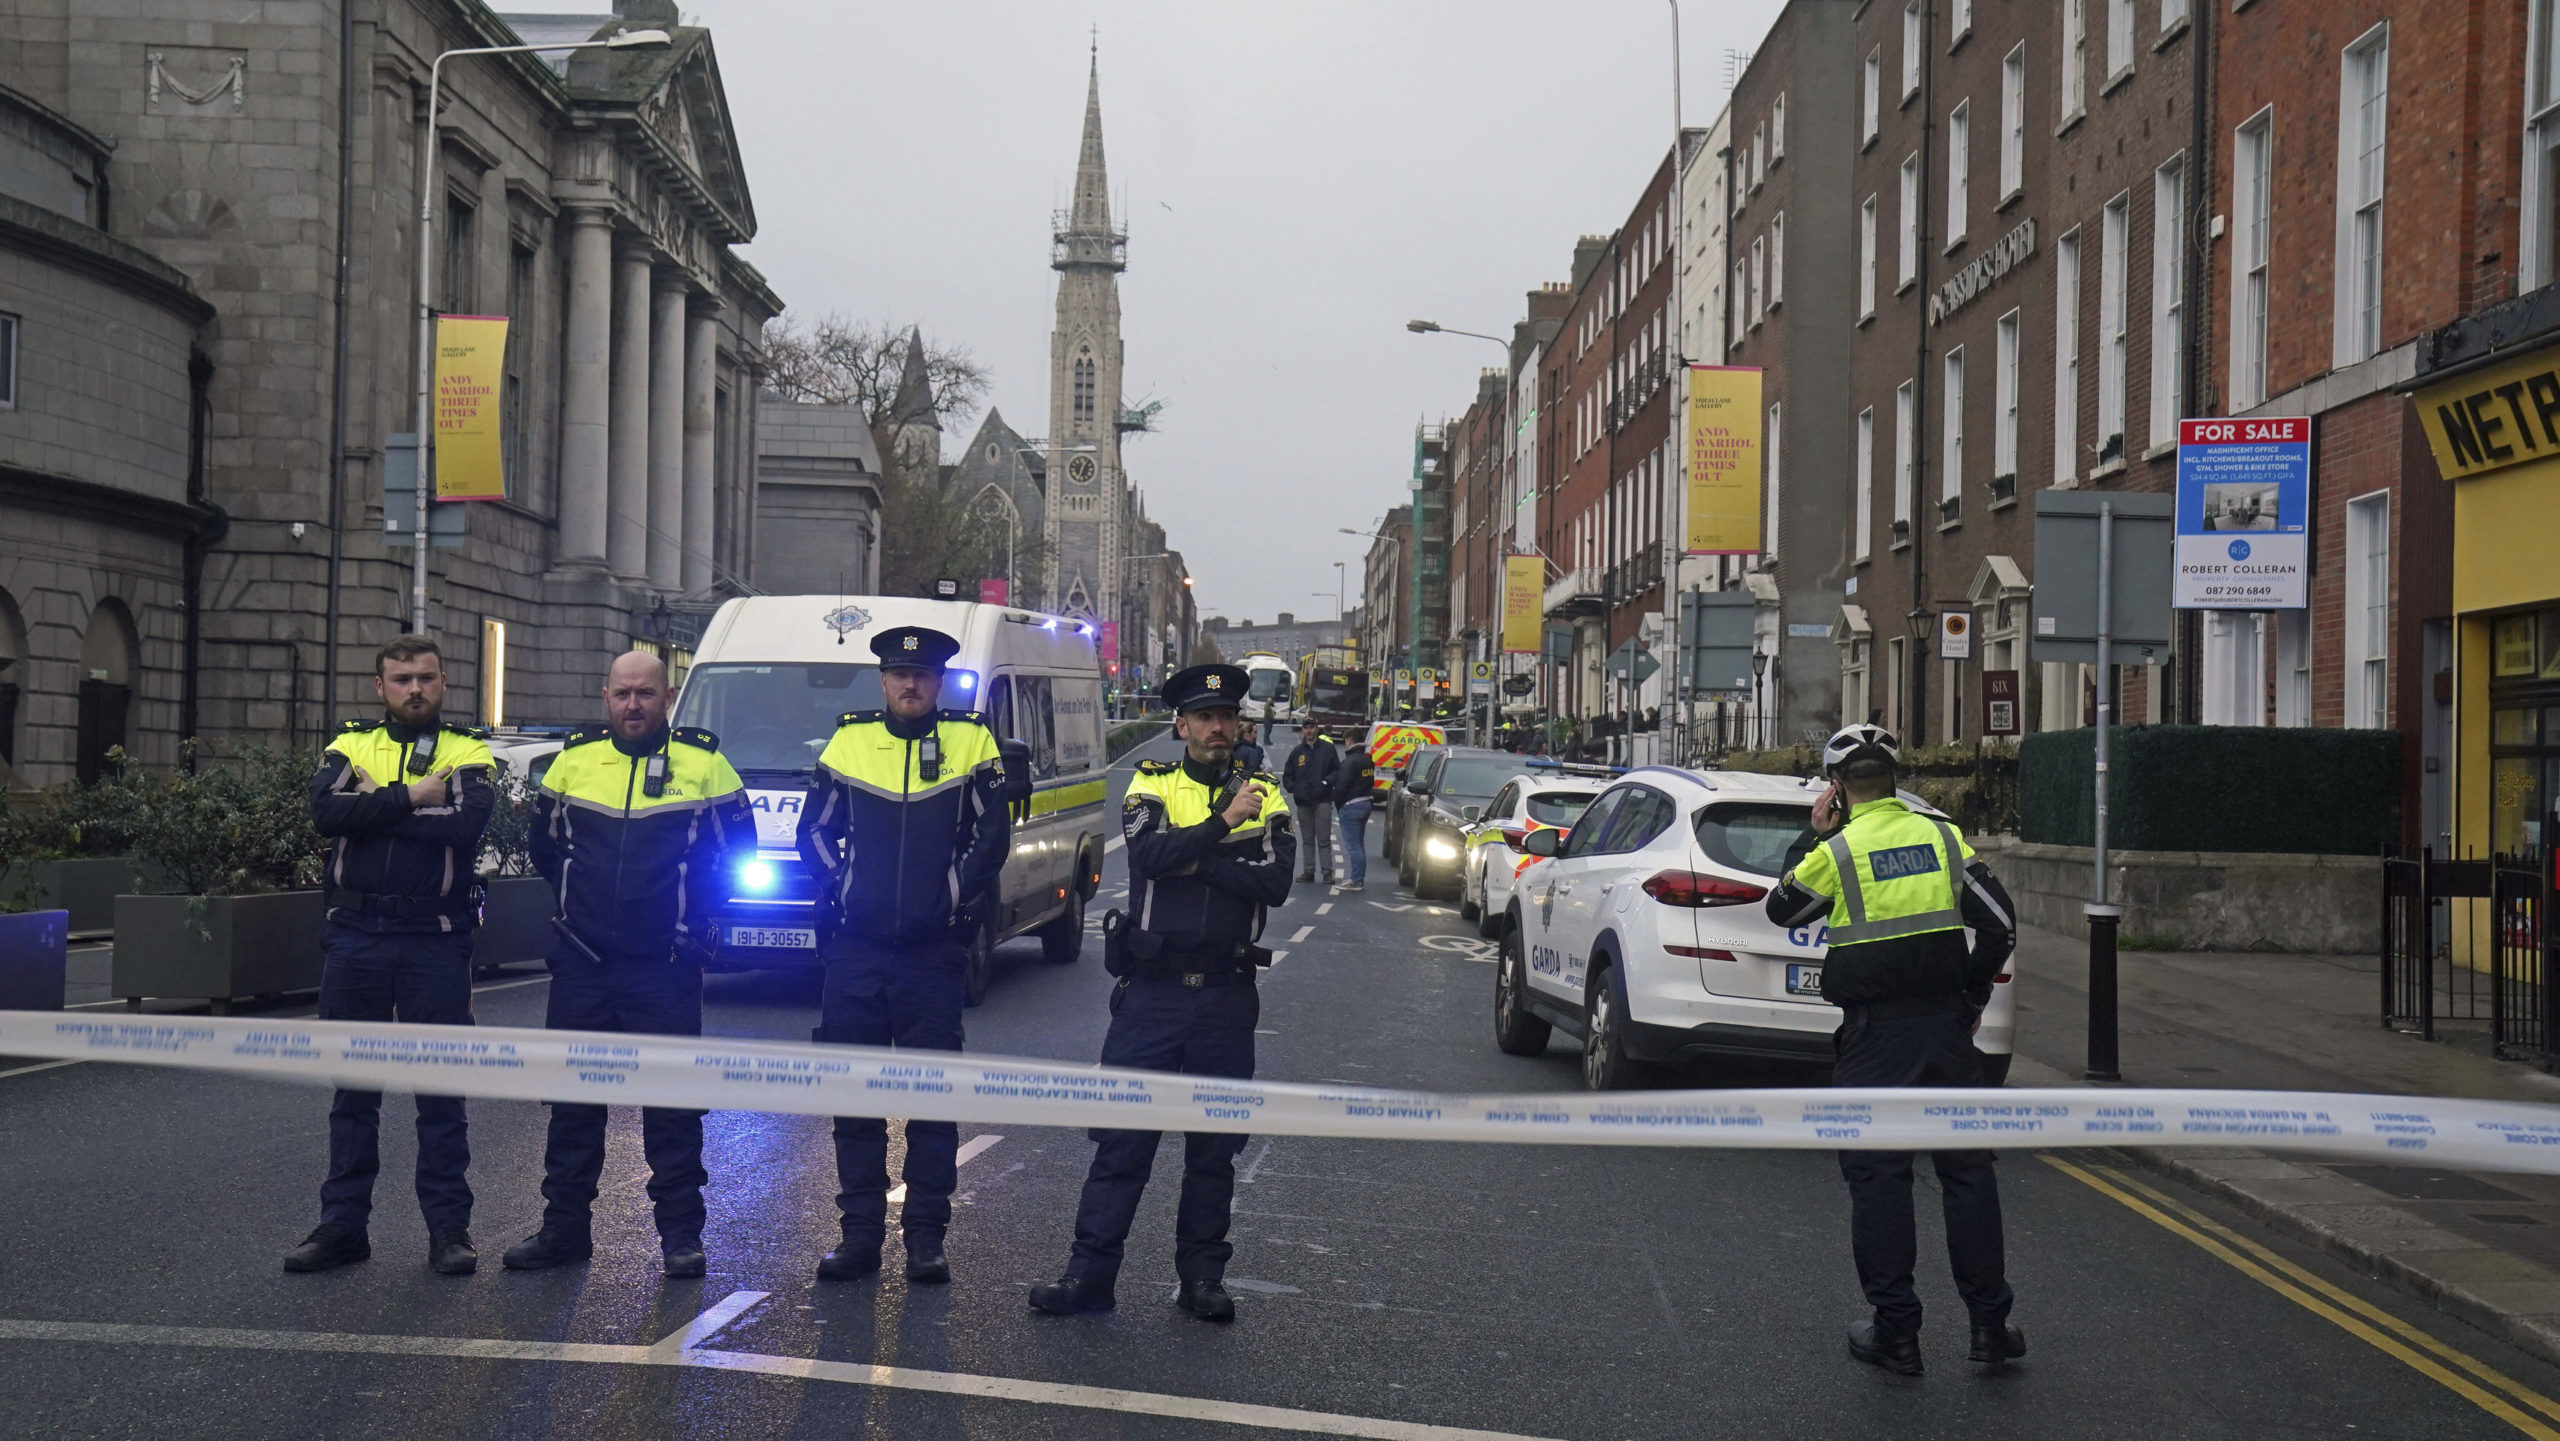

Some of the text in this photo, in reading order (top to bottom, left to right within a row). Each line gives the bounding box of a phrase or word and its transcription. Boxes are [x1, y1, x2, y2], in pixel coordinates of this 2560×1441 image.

[442, 376, 472, 384] ANDY
[440, 386, 493, 396] WARHOL
[440, 398, 480, 406] THREE
[440, 408, 476, 417] TIMES
[2437, 369, 2560, 468] NETP
[440, 420, 464, 429] OUT
[1696, 427, 1730, 436] ANDY
[2194, 423, 2294, 441] FOR SALE
[1695, 439, 1754, 448] WARHOL
[1695, 450, 1740, 459] THREE
[1694, 461, 1736, 470] TIMES
[1694, 472, 1723, 481] OUT
[2182, 565, 2296, 574] ROBERT COLLERAN
[2206, 586, 2271, 595] 087 290 6849
[1946, 644, 1964, 652] Hotel
[1992, 680, 2008, 694] SIX
[1392, 736, 1428, 745] GARDA
[664, 788, 683, 796] RDA
[1872, 847, 1938, 877] GARDA
[737, 931, 809, 946] 191-D-30557
[1708, 936, 1748, 947] HYUNDAI
[1532, 944, 1560, 978] GARDA
[292, 1035, 310, 1046] NO
[420, 1040, 468, 1052] GARDA
[470, 1042, 489, 1054] AN
[480, 1058, 524, 1069] UIMHIR
[566, 1057, 639, 1070] Confidential
[694, 1054, 850, 1074] COSC AR DHUL ISTEACH
[579, 1071, 626, 1085] GARDA
[722, 1068, 822, 1085] LÁTHAIR COIRE
[880, 1066, 944, 1082] NO ENTRY
[982, 1070, 1049, 1086] SÍOCHÁNA
[866, 1077, 953, 1092] CRIME SCENE
[1052, 1075, 1098, 1088] GARDA
[1100, 1078, 1118, 1089] AN
[974, 1084, 1152, 1104] UIMHIR THEILEAFÓIN RÚNDA
[1192, 1093, 1264, 1107] Confidential
[1204, 1107, 1250, 1121] GARDA
[1346, 1104, 1442, 1120] LÁTHAIR COIRE
[1486, 1110, 1570, 1124] CRIME SCENE
[1924, 1104, 2068, 1118] COSC AR DHUL ISTEACH
[2096, 1106, 2154, 1118] NO ENTRY
[2248, 1109, 2290, 1120] GARDA
[1590, 1112, 1634, 1125] RÚNDA
[1720, 1114, 1764, 1126] UIMHIR
[1802, 1113, 1872, 1126] Confidential
[1950, 1119, 2042, 1132] LÁTHAIR COIRE
[2128, 1120, 2164, 1132] CRIME
[1816, 1128, 1860, 1138] GARDA
